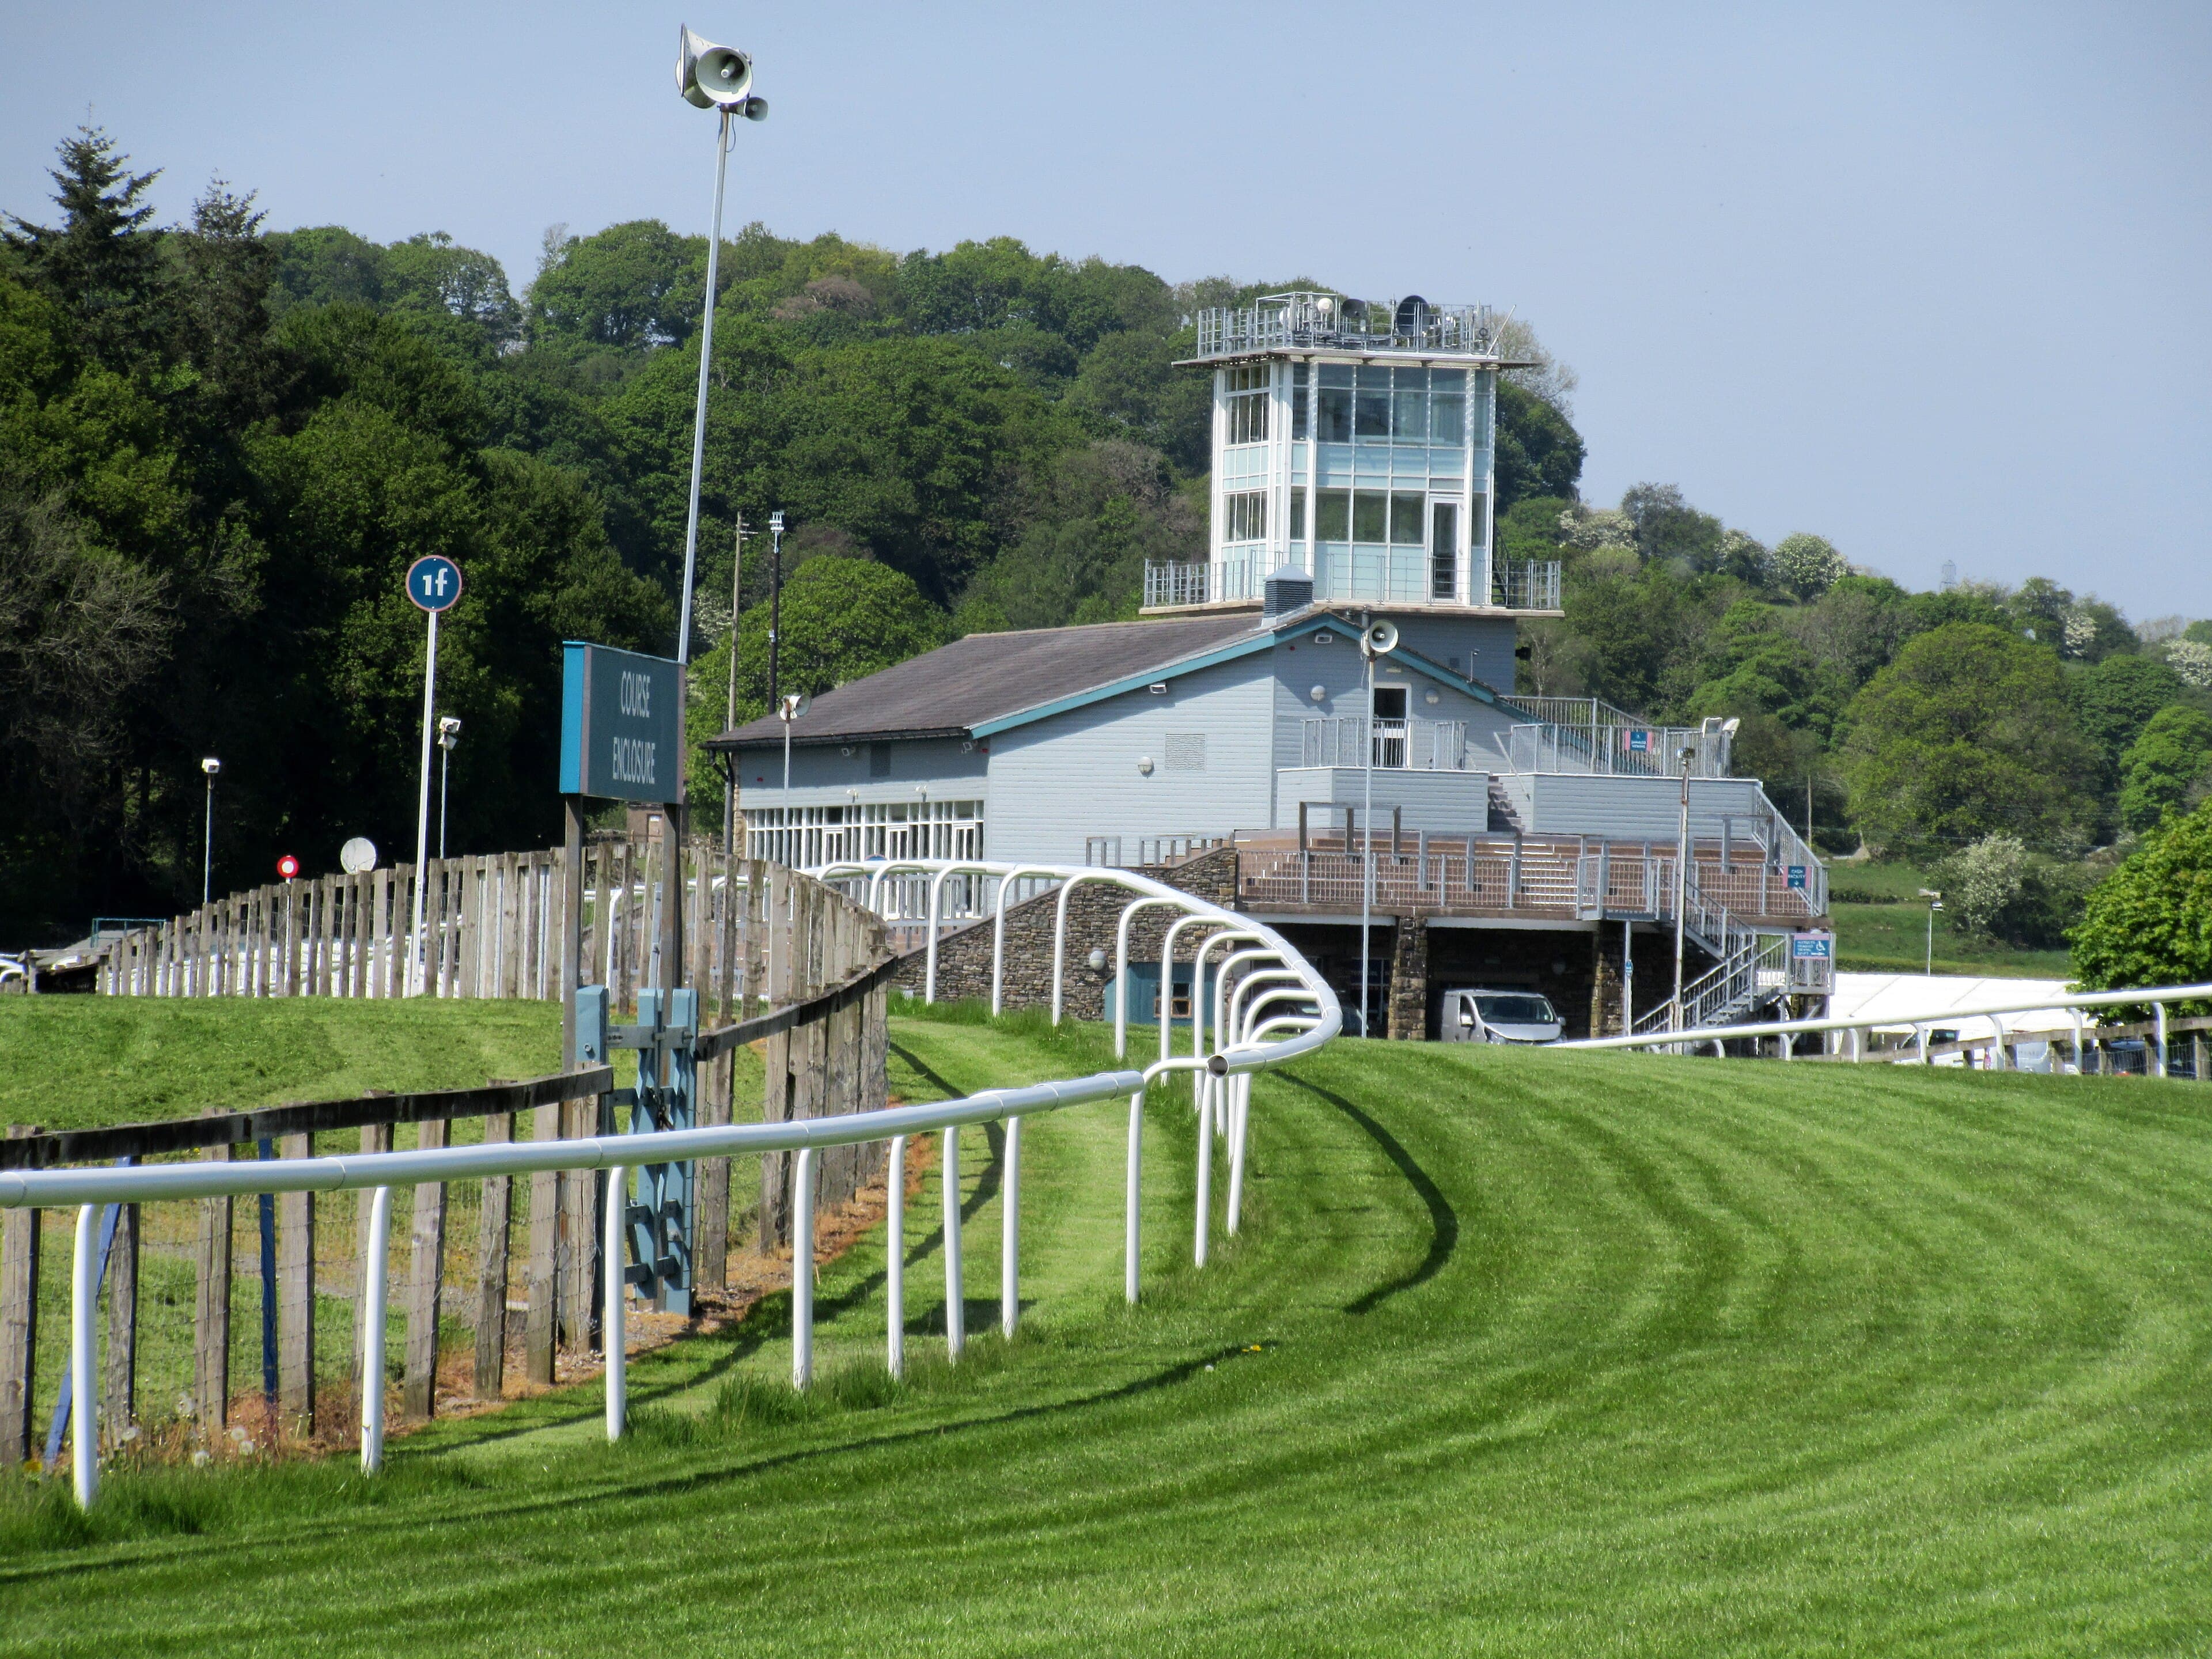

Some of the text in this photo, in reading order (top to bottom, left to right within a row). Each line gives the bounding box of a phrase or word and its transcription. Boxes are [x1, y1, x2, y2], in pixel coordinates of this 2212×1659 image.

[423, 568, 448, 596] 1f
[621, 671, 651, 718] COURSE
[612, 737, 656, 784] ENCLOSURE
